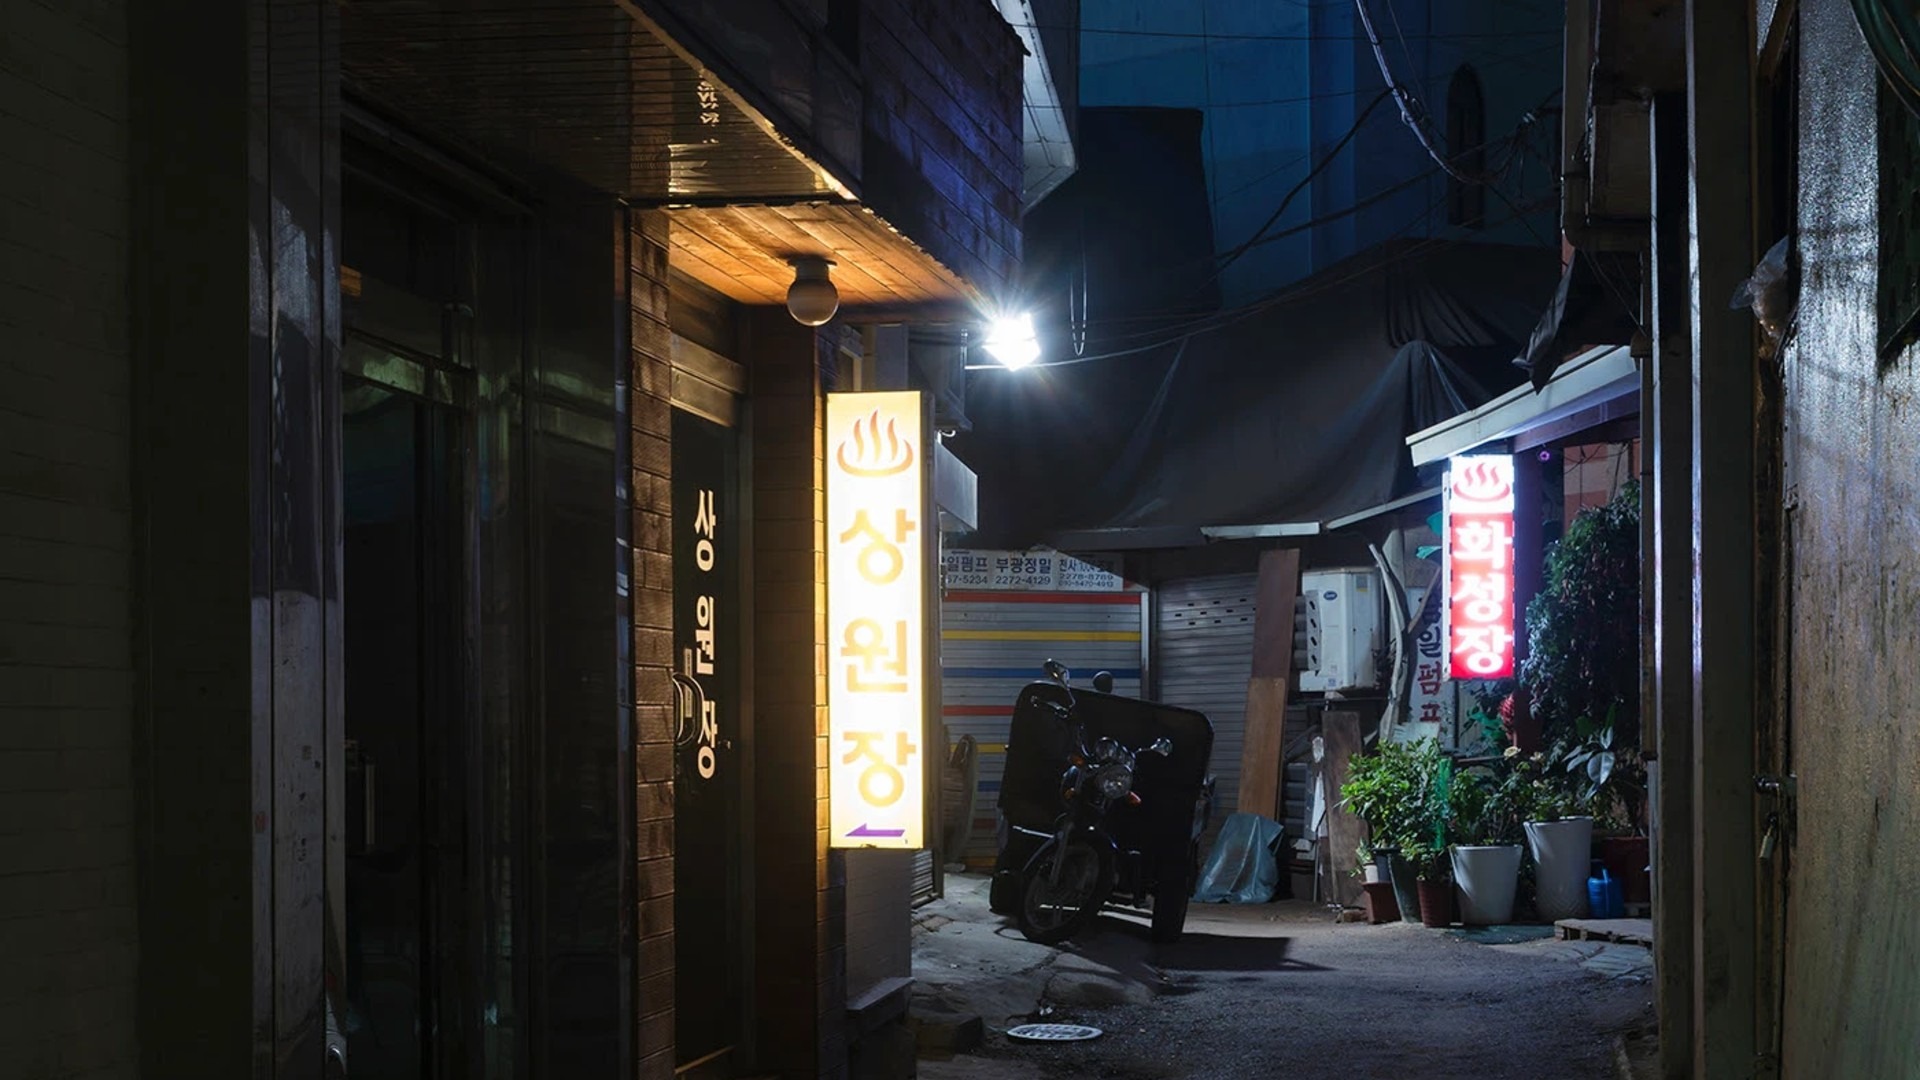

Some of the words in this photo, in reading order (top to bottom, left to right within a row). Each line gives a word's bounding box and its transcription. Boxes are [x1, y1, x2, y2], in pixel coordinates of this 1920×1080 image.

[694, 488, 718, 779] 상원장
[942, 556, 989, 573] 일펌프
[995, 557, 1052, 574] 부광정밀
[995, 575, 1051, 585] 2272-4129
[839, 508, 916, 808] 상원장
